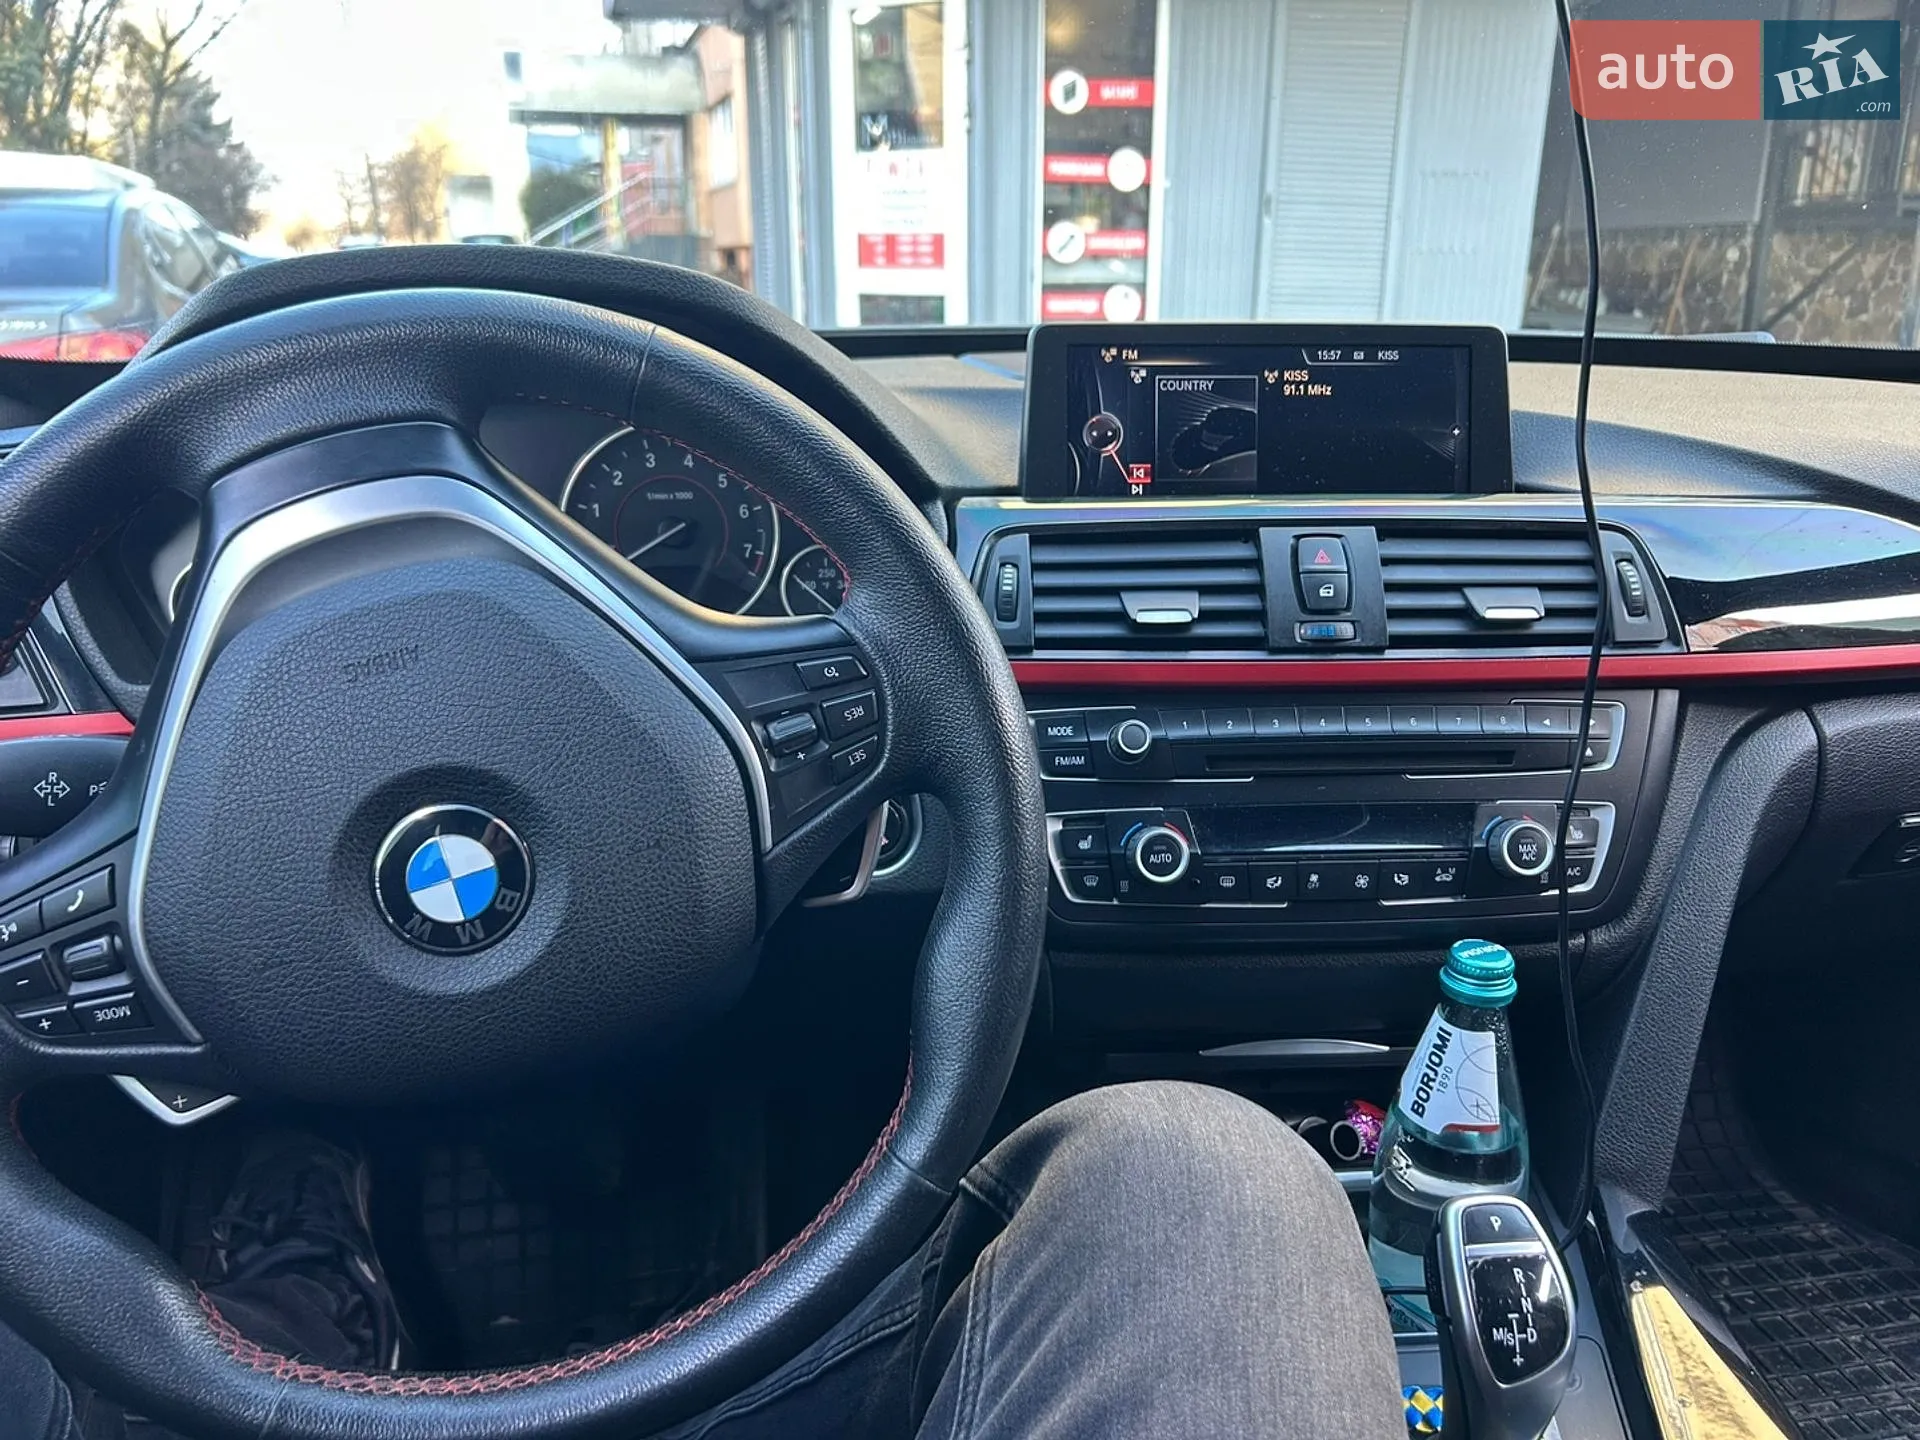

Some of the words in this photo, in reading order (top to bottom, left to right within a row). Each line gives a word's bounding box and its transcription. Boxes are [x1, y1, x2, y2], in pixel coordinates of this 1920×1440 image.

[1122, 349, 1138, 360] FM
[1317, 350, 1341, 360] 15:57
[1377, 350, 1399, 360] KISS
[1283, 370, 1309, 381] KISS
[1159, 380, 1215, 392] COUNTRY
[1283, 384, 1304, 396] 91.1
[1307, 384, 1332, 396] MHz
[645, 454, 656, 468] 3
[683, 454, 694, 468] 4
[612, 471, 623, 486] 2
[718, 473, 728, 488] 5
[592, 503, 600, 517] 1
[739, 504, 749, 518] 6
[744, 544, 754, 558] 7
[843, 705, 865, 722] RES
[1182, 720, 1188, 730] 1
[1226, 719, 1233, 730] 2
[1271, 718, 1279, 729] 3
[1319, 717, 1326, 728] 4
[1365, 717, 1373, 727] 5
[1409, 716, 1417, 726] 6
[1455, 716, 1462, 726] 7
[1047, 726, 1074, 737] MODE
[848, 749, 867, 767] SET
[1054, 755, 1085, 766] FM/AM
[48, 771, 57, 783] R
[47, 795, 56, 807] L
[1518, 843, 1538, 853] MAX
[1149, 852, 1172, 864] AUTO
[1521, 853, 1537, 861] A/C
[1566, 866, 1581, 877] A/C
[404, 886, 521, 945] BMW
[94, 1004, 131, 1022] MODE
[1410, 1026, 1453, 1119] BORJOMI
[1436, 1065, 1454, 1095] 1890
[1489, 1215, 1502, 1232] P
[1513, 1267, 1526, 1284] R
[1520, 1296, 1534, 1314] N
[1526, 1327, 1538, 1343] D
